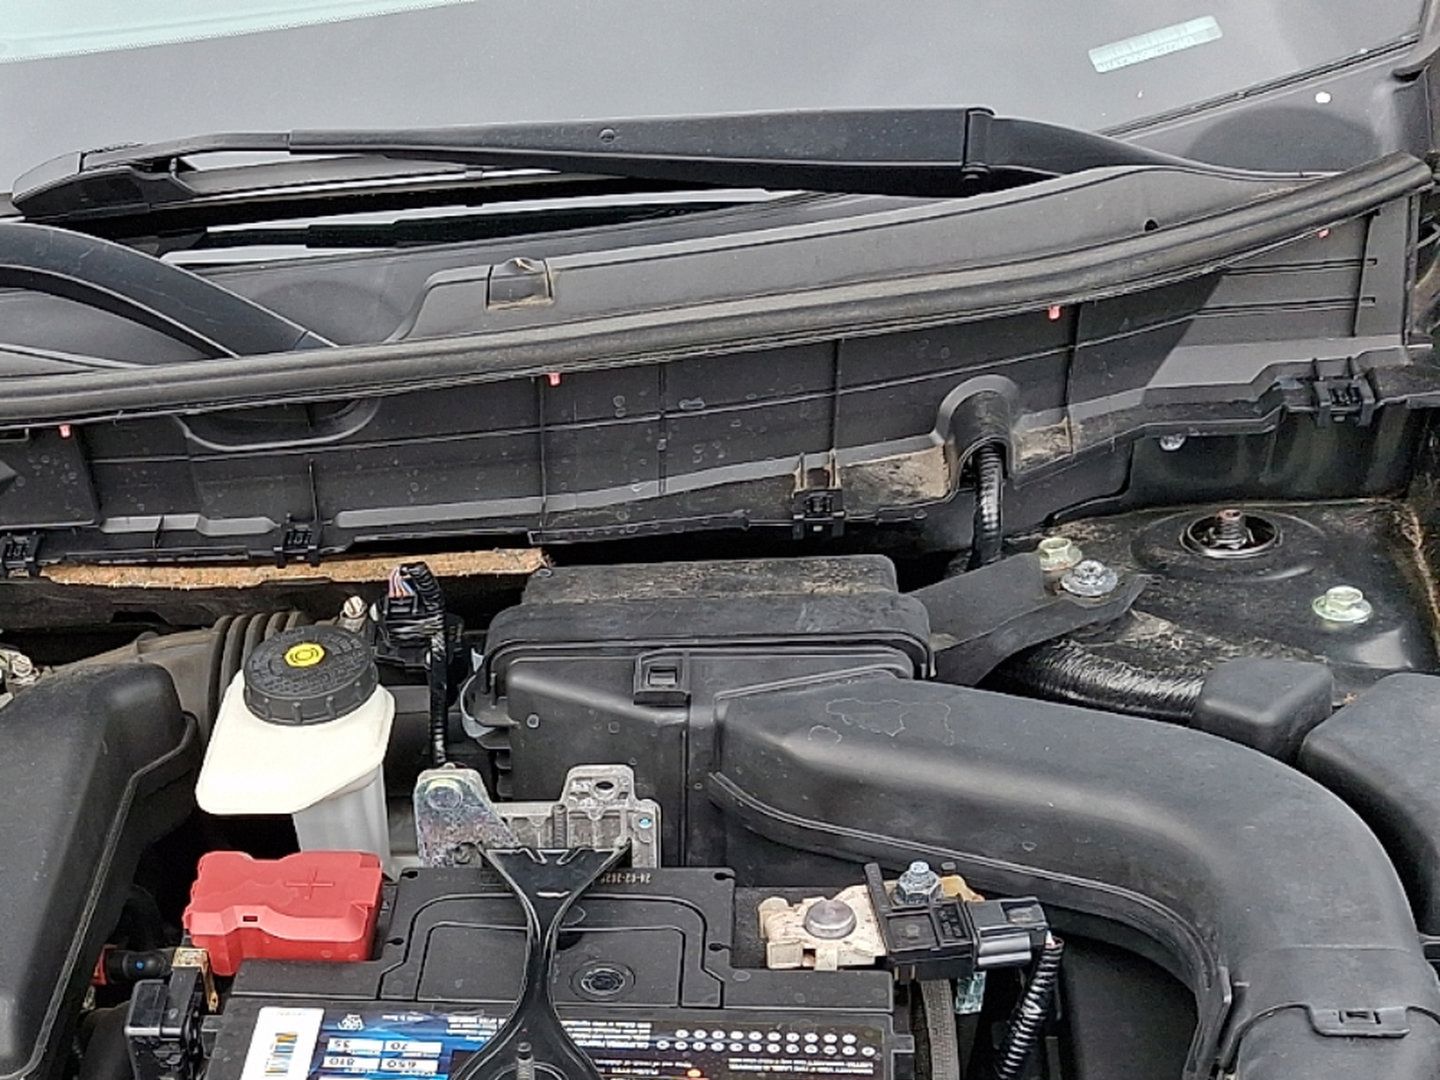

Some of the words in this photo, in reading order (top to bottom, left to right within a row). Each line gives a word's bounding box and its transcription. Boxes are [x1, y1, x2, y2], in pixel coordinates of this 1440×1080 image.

[333, 1038, 351, 1047] 35
[389, 1041, 410, 1051] 70
[328, 1055, 355, 1066] 810
[385, 1059, 417, 1069] 650
